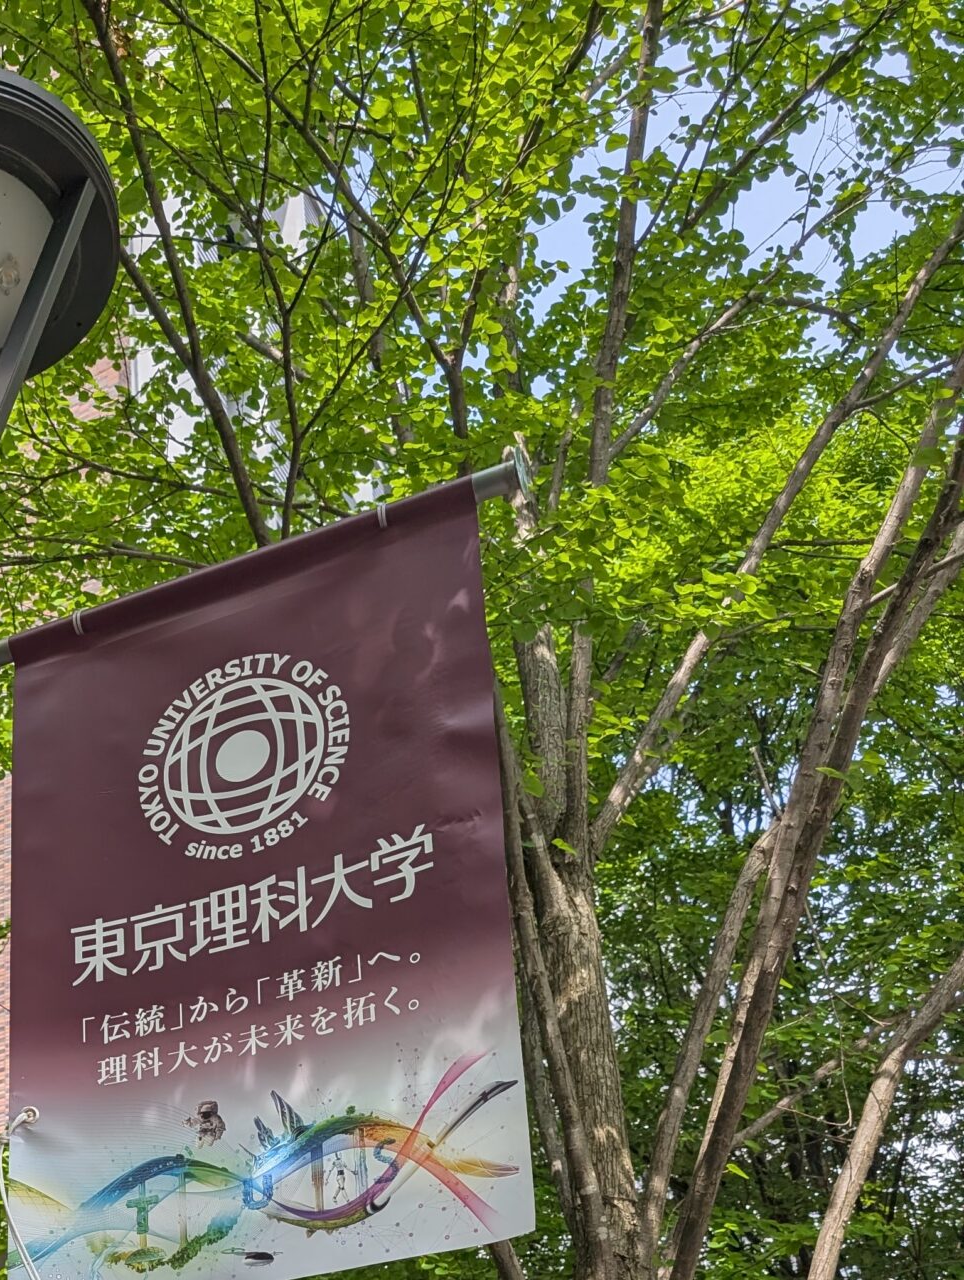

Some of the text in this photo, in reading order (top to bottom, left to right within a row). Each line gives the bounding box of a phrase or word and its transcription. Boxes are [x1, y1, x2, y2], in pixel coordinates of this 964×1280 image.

[138, 653, 350, 846] TOKYO UNIVERSITY OF SCIENCE
[185, 811, 309, 860] since 1881
[70, 824, 434, 987] 東京理科大学
[82, 951, 421, 1043] 「伝統」から「革新」へ。
[97, 986, 420, 1087] 理科大が未来を拓く。
